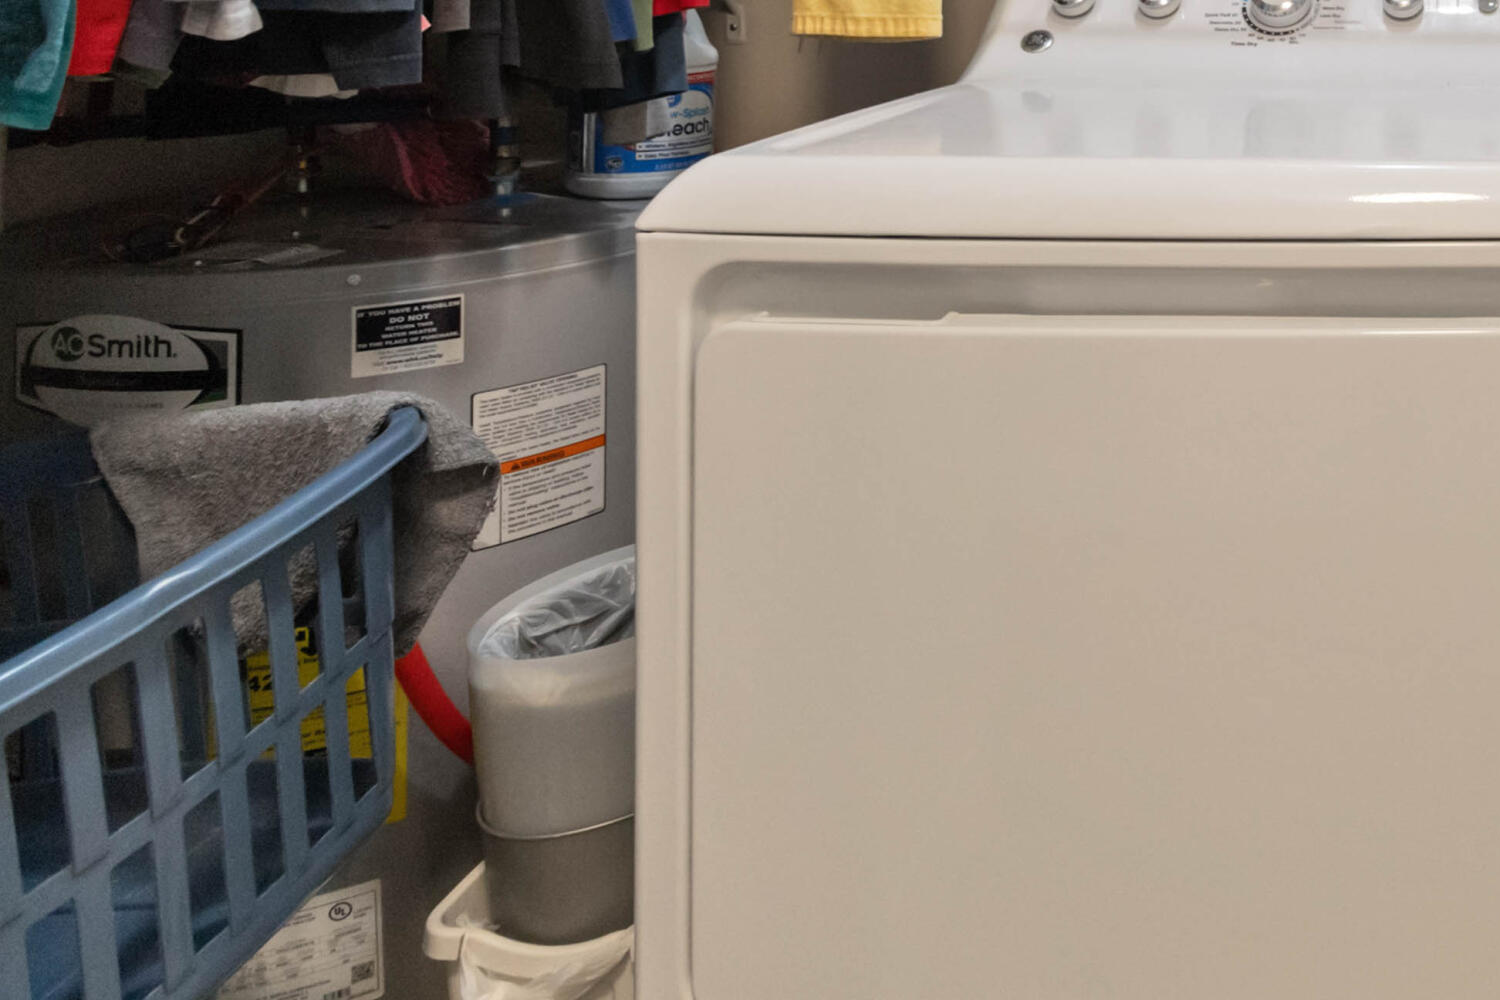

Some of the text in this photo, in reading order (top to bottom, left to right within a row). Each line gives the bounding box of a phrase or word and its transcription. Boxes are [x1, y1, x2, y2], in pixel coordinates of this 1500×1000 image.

[388, 307, 411, 315] HAVE
[421, 300, 461, 310] PROBLEM
[389, 313, 431, 324] DO NOT
[385, 323, 416, 331] RETURN
[381, 331, 407, 339] WATER
